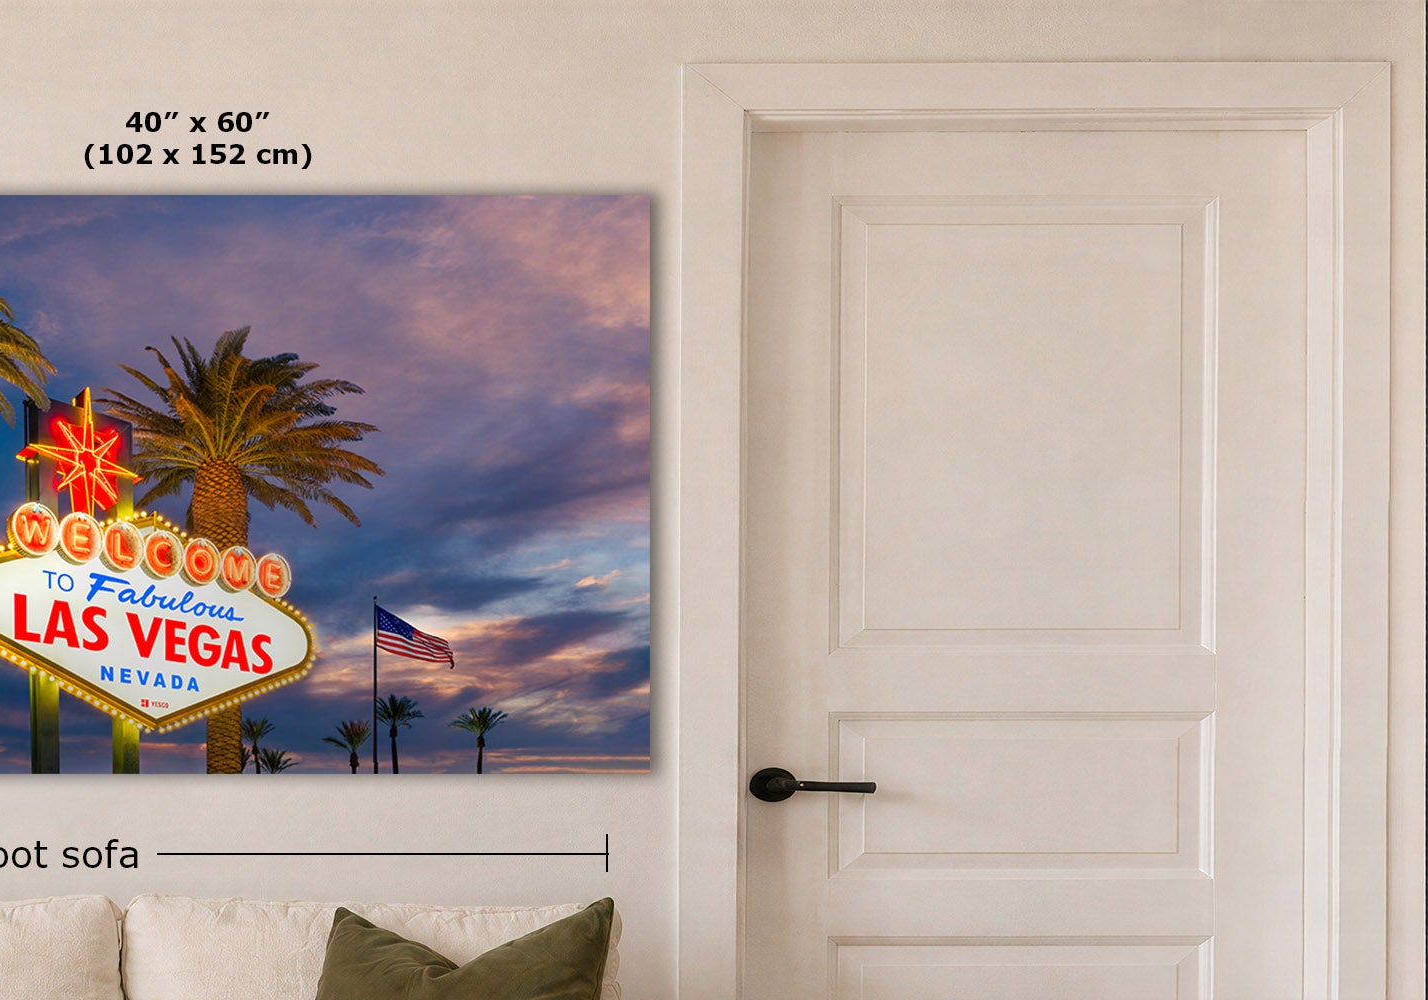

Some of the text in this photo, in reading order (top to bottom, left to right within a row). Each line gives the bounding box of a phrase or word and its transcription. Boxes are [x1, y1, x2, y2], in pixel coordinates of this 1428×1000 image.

[17, 513, 285, 591] WELCOME
[42, 570, 245, 622] TO Fabulous
[13, 592, 274, 675] LAS VEGAS
[99, 665, 200, 693] NEVADA
